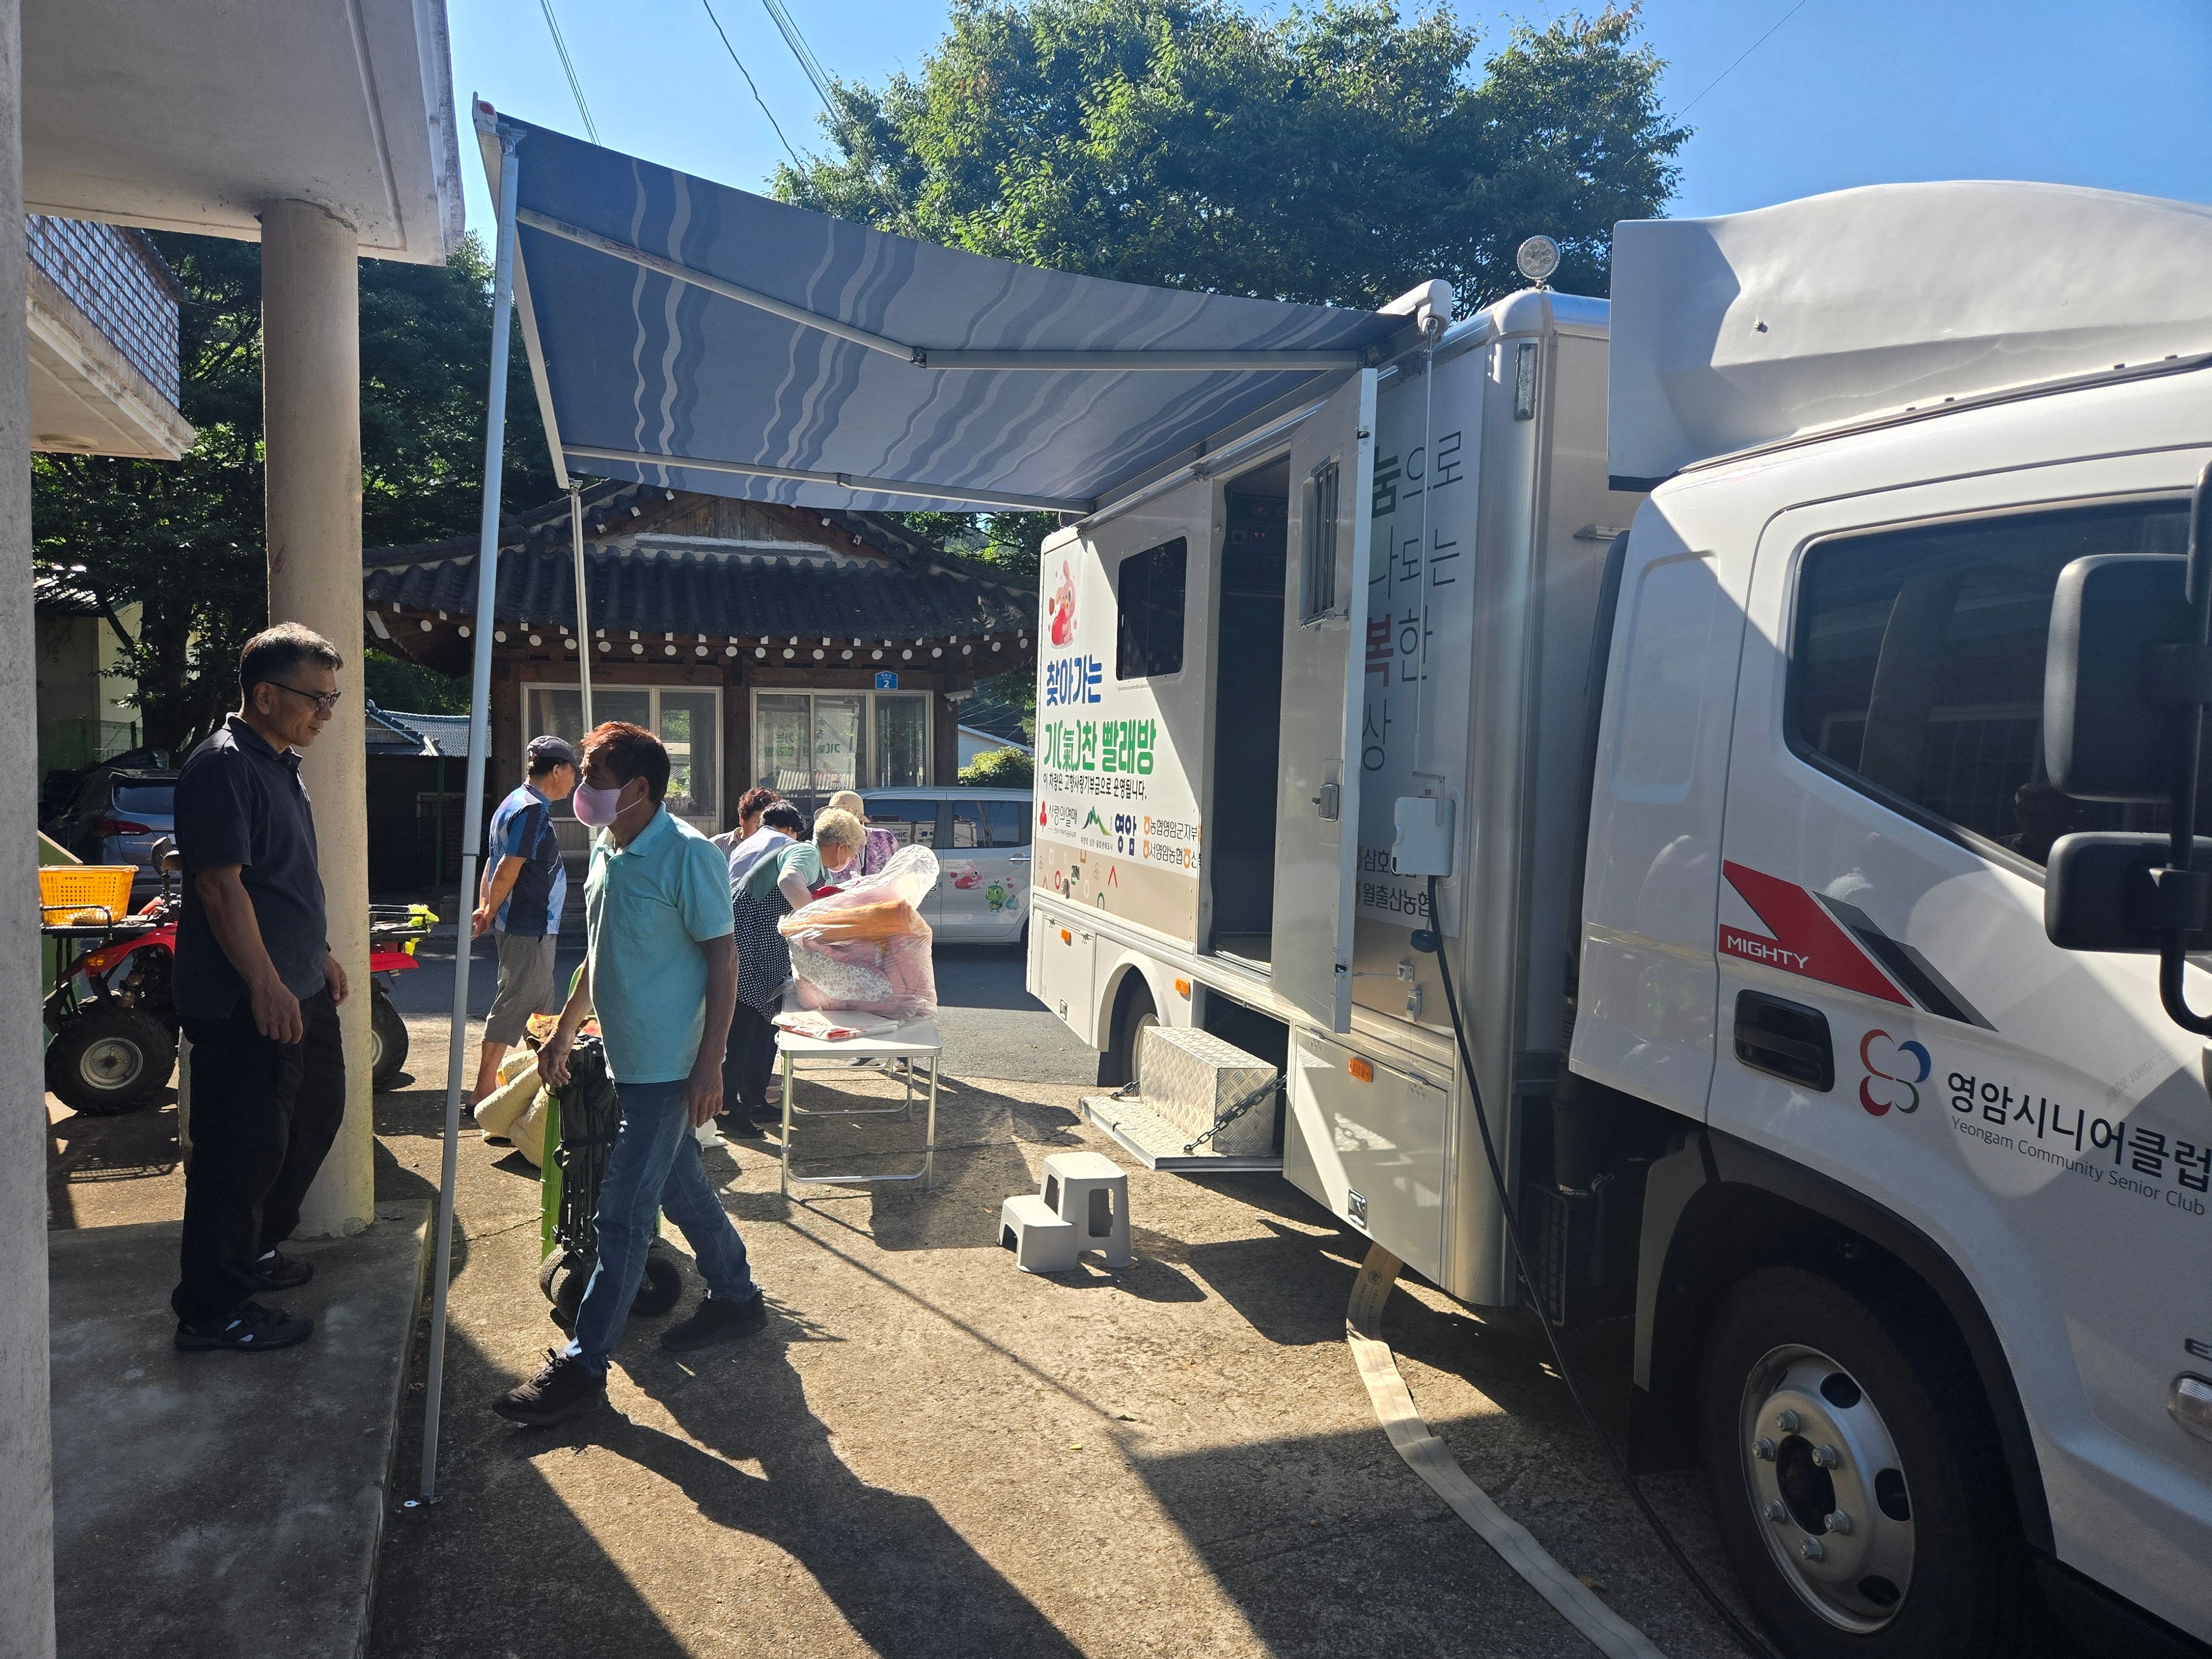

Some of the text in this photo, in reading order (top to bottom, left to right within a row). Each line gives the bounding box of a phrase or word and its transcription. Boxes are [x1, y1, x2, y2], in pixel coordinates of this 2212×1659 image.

[1372, 430, 1463, 519] 눔으로
[1369, 526, 1460, 600] 나되는
[1365, 605, 1433, 687] 복한
[884, 680, 890, 688] 2
[1046, 654, 1102, 707] 찾아가는
[1044, 718, 1157, 775] 기(氣)찬 빨래방
[1362, 699, 1392, 771] 상
[1043, 772, 1147, 801] 이 차량은 고향사랑기부금으로 운영됩니다.
[1048, 805, 1077, 828] 사랑의열매
[1115, 813, 1137, 856] 영암
[1150, 818, 1198, 842] 농협영암군지부
[1149, 842, 1183, 865] 서영암농협
[1363, 849, 1417, 879] 삼호
[1363, 883, 1430, 917] 월출산농협
[1727, 935, 1810, 969] MIGHTY
[1947, 1072, 2212, 1193] 영암시니어클럽
[1952, 1116, 2205, 1216] Yeongam Community Senior Club
